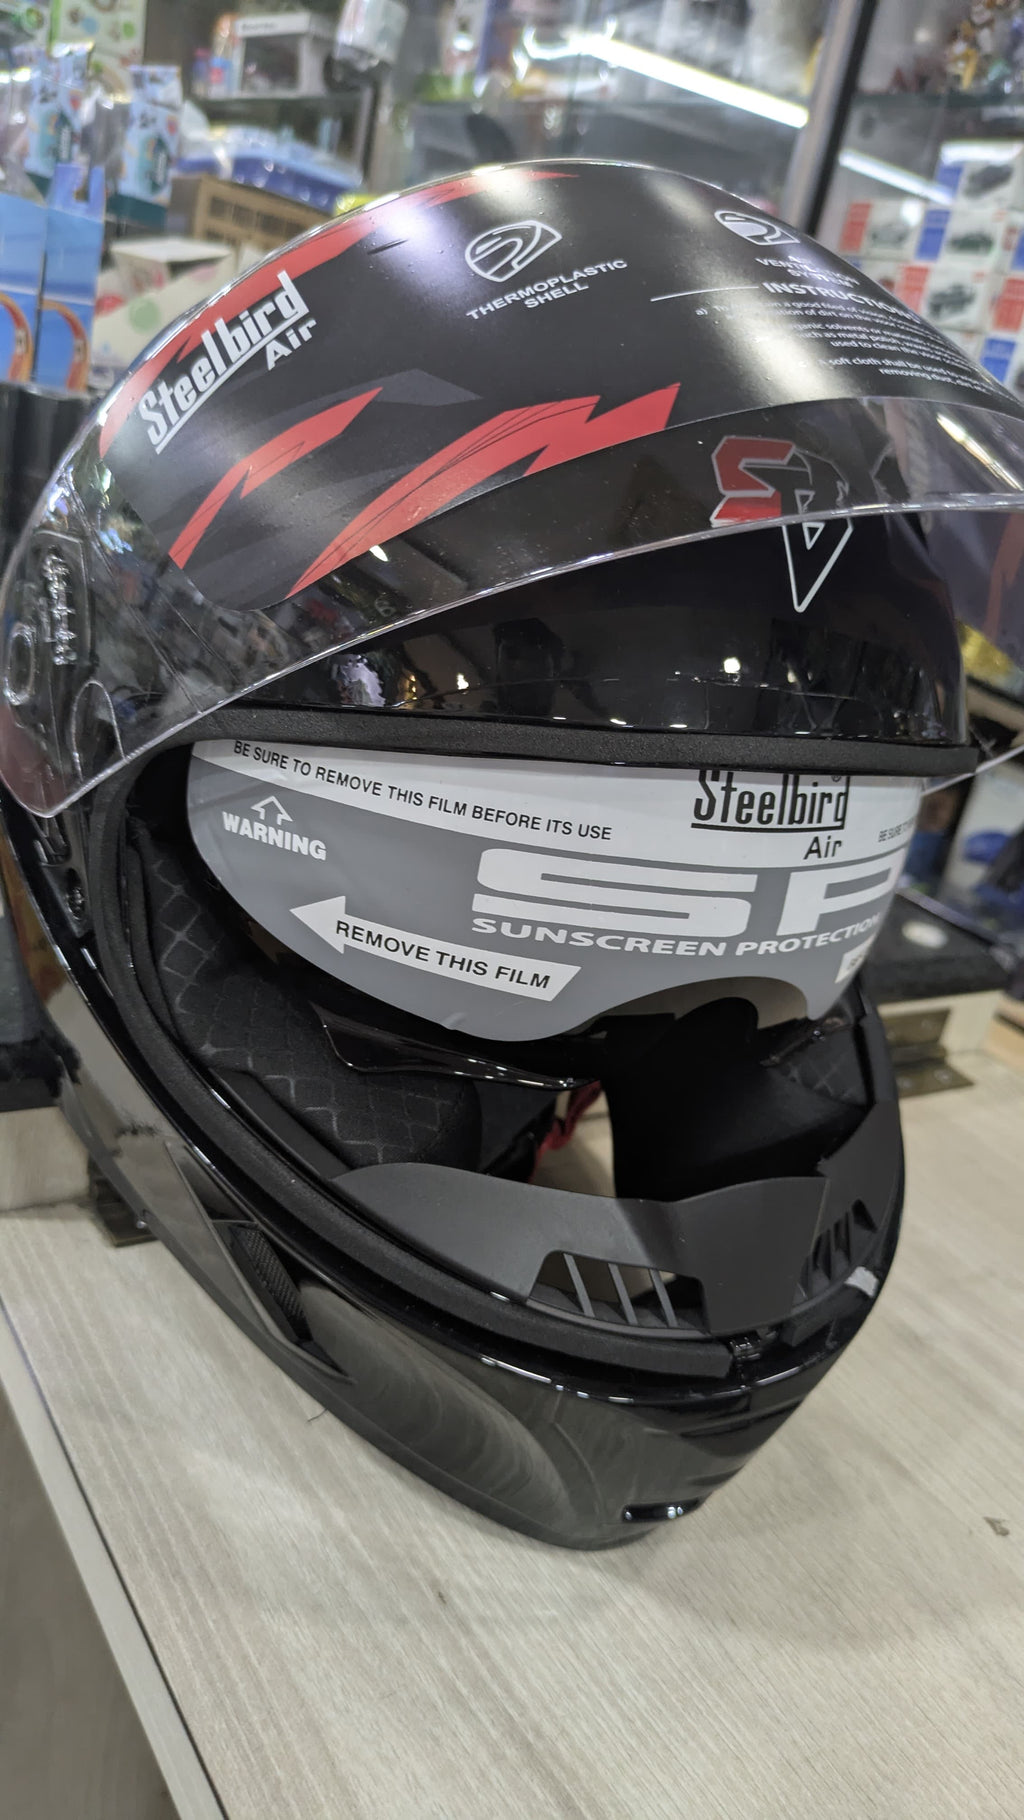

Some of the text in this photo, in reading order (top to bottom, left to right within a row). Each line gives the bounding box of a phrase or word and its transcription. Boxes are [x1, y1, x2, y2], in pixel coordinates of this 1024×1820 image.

[466, 259, 628, 320] THERMOPLASTIC
[524, 282, 589, 309] SHELL
[762, 281, 921, 325] INSTRUCTION
[792, 302, 821, 310] good
[266, 318, 317, 371] Air
[789, 323, 825, 331] rganic
[138, 270, 310, 450] Steelbird
[852, 356, 881, 366] cloth
[233, 740, 613, 841] BE SURE TO REMOVE THIS FILM BEFORE ITS USE
[692, 770, 850, 829] Steelbird
[222, 811, 327, 861] WARNING
[803, 835, 842, 860] Air
[336, 920, 550, 989] REMOVE THIS FILM
[471, 912, 881, 957] SUNSCREEN PROTECTION
